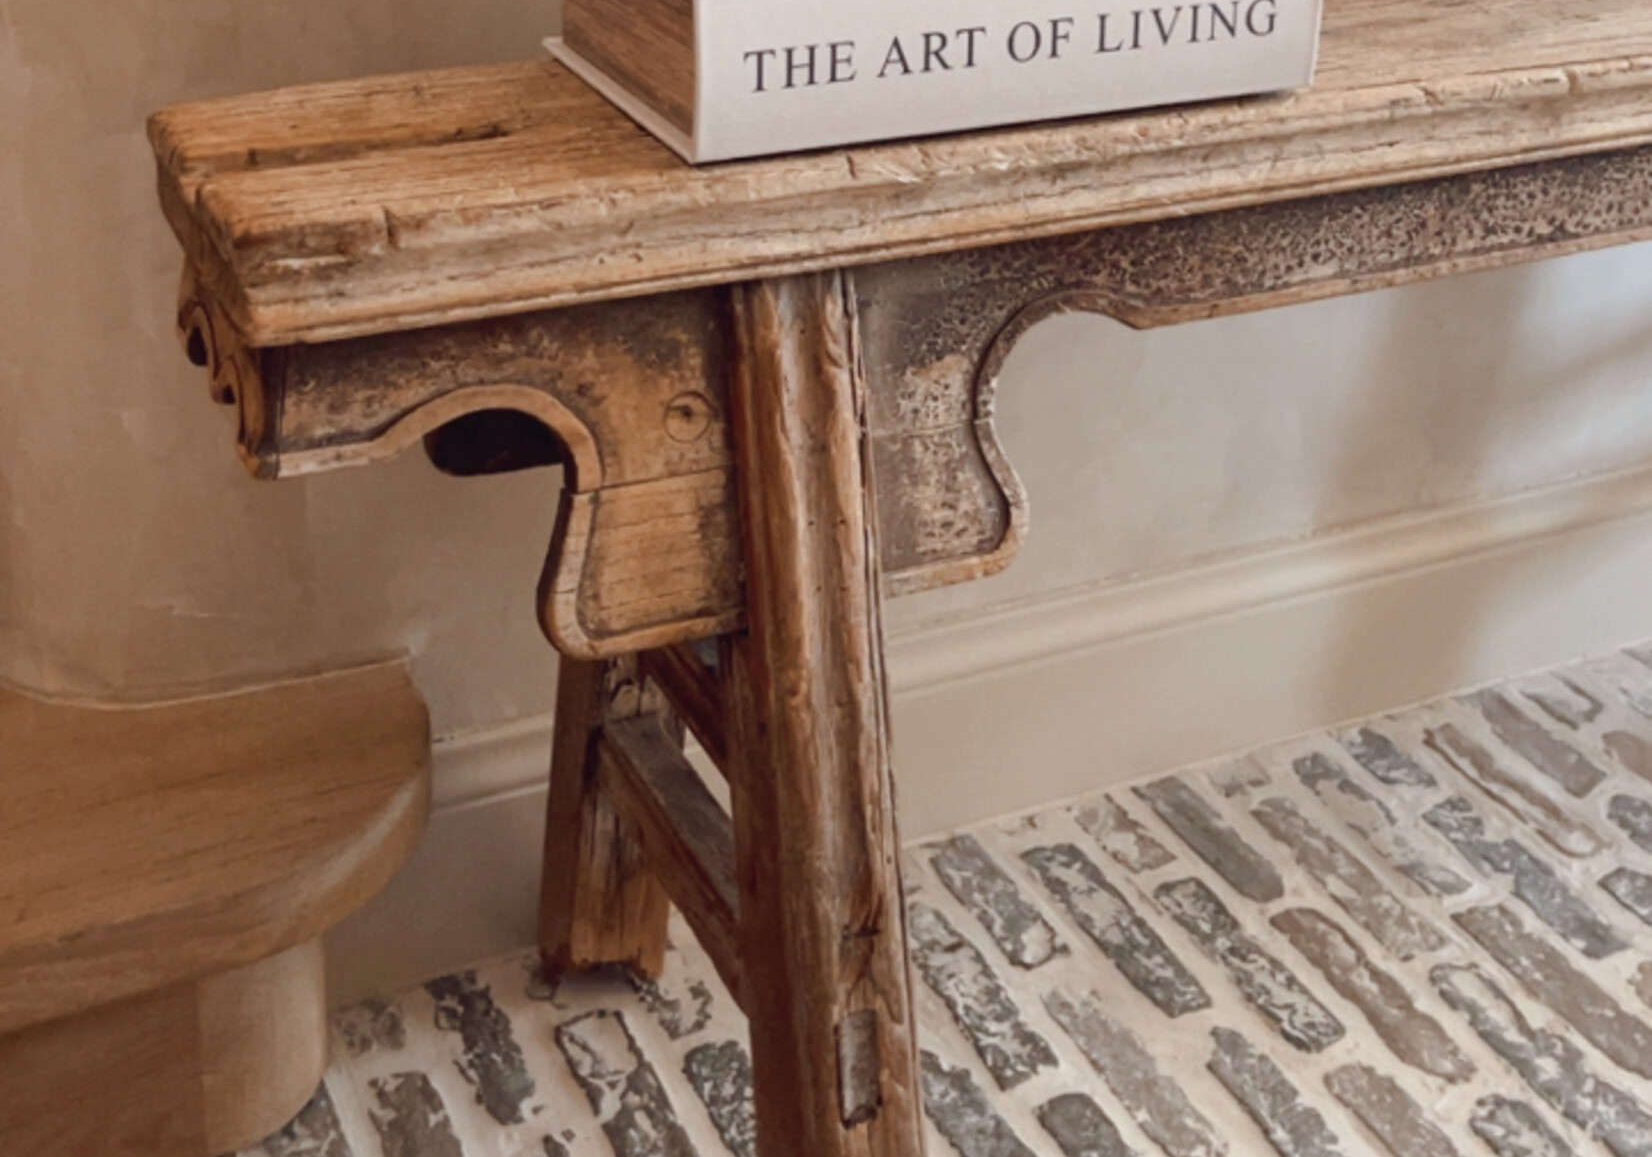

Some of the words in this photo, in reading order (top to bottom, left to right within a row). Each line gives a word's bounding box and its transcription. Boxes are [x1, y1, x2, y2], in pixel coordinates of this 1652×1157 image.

[743, 40, 858, 94] THE
[876, 26, 988, 79] ART
[1005, 17, 1075, 64] OF
